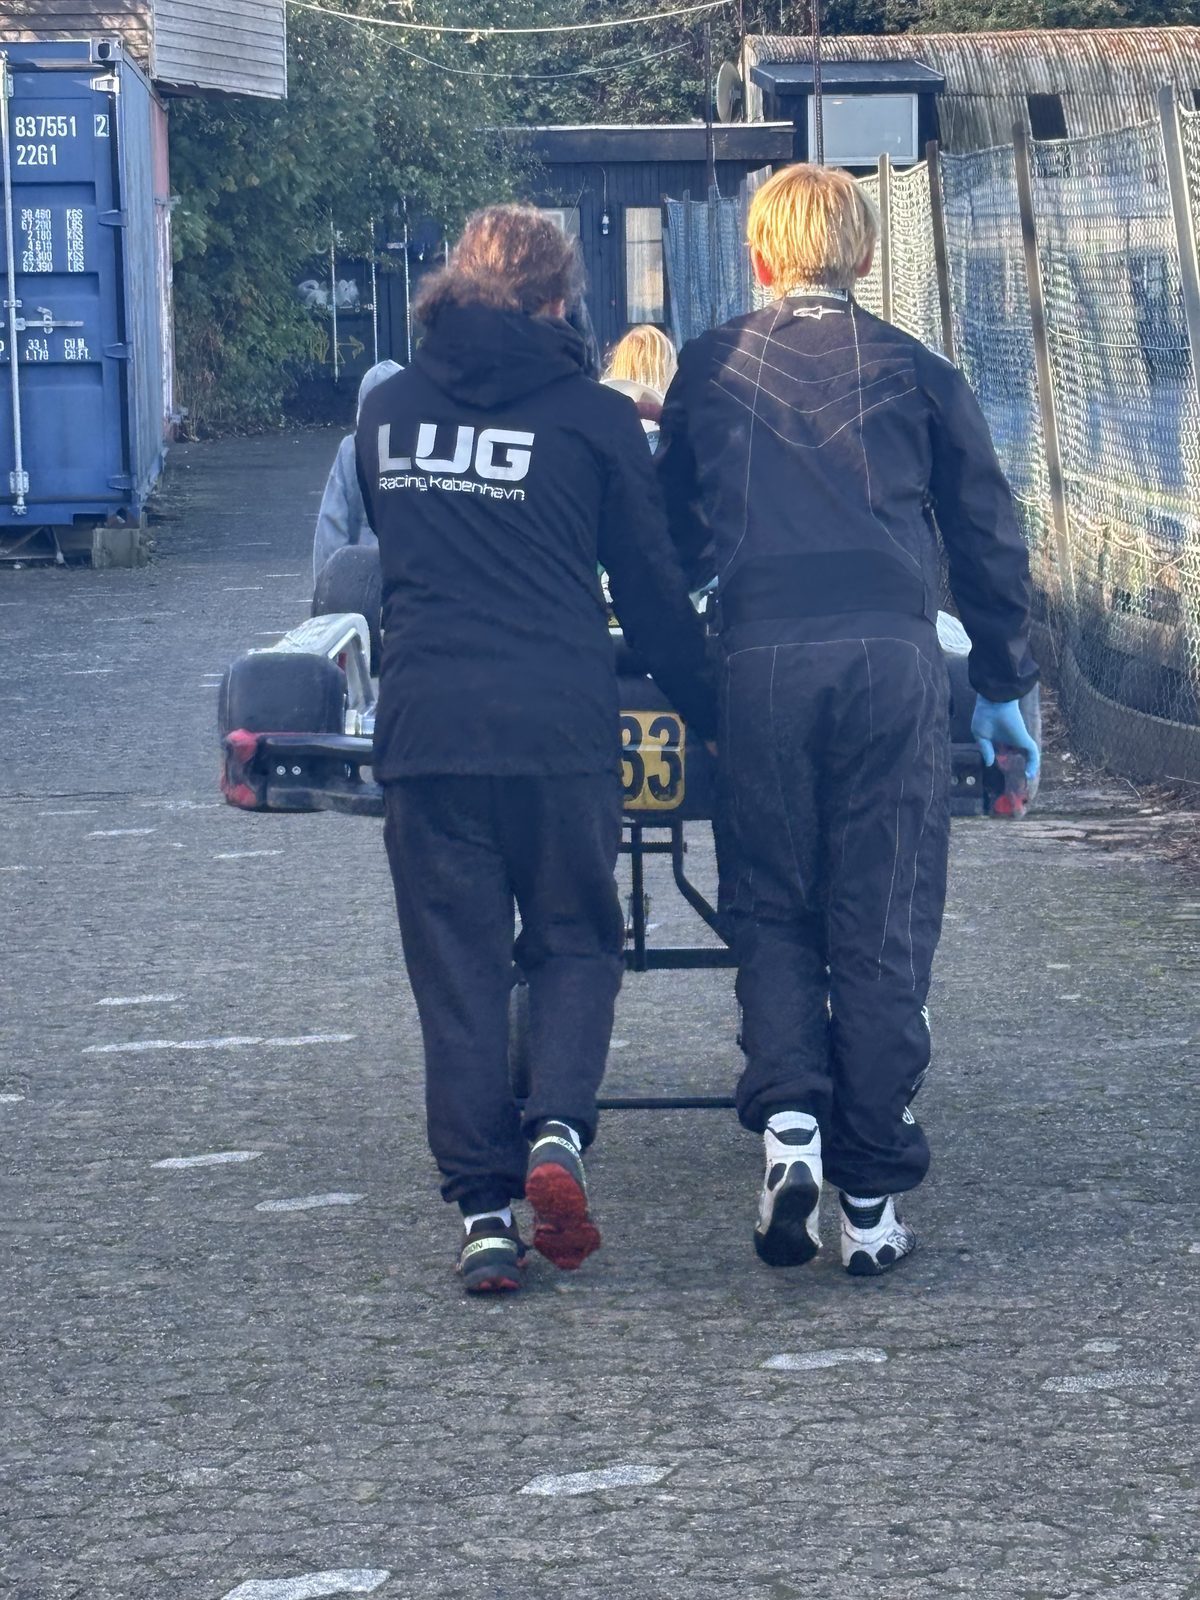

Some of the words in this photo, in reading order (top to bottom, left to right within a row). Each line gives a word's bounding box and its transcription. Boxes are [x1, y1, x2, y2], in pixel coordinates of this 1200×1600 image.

[15, 115, 77, 138] 837551
[96, 115, 108, 137] 2
[16, 144, 57, 166] 22G1
[377, 422, 535, 482] LUG
[378, 474, 428, 492] Racing
[429, 474, 526, 501] København
